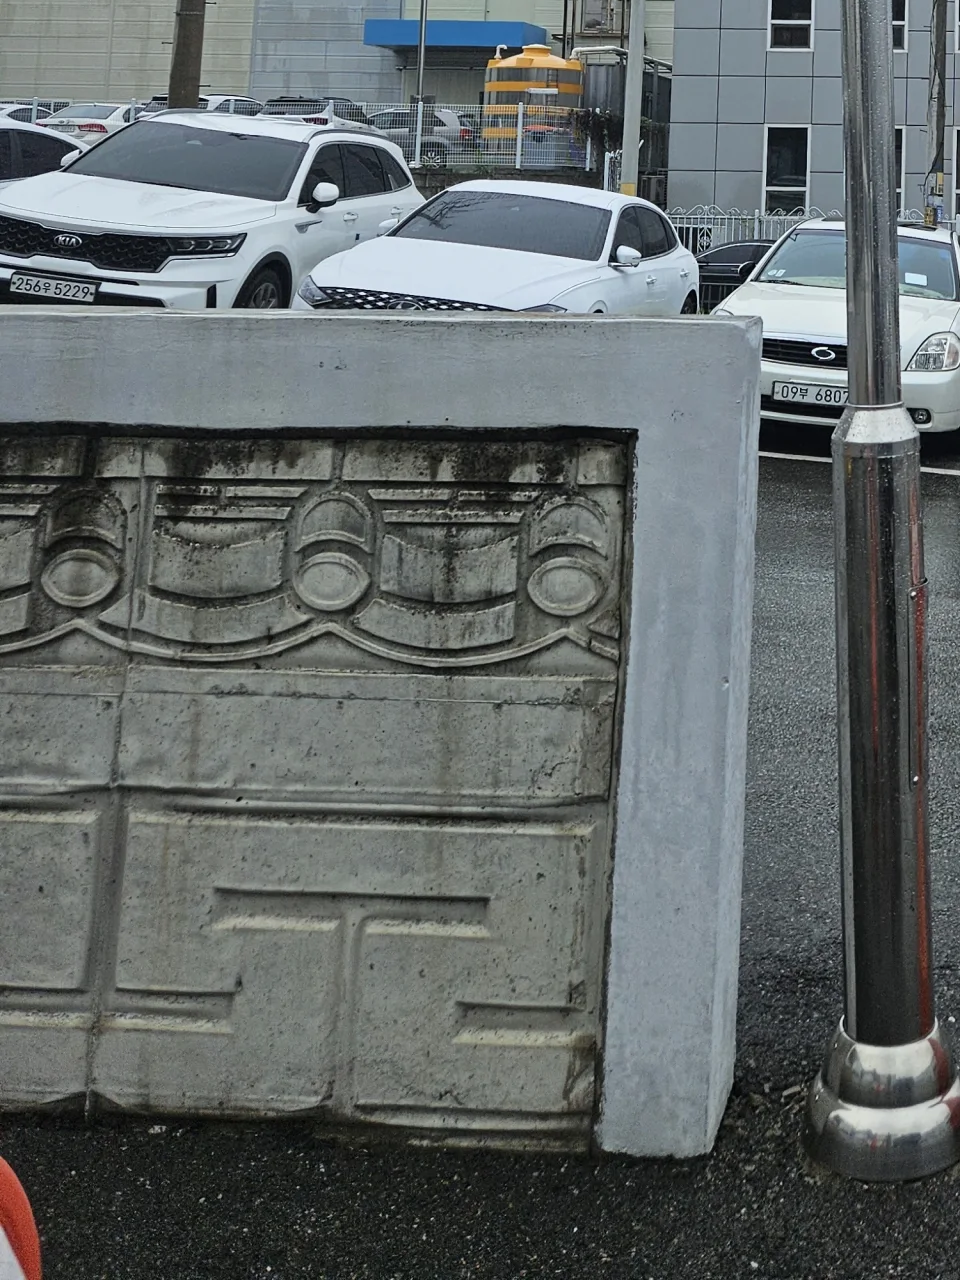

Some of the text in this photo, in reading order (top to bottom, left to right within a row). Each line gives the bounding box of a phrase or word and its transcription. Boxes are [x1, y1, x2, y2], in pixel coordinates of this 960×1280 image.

[15, 277, 90, 299] 256우 5229
[815, 388, 849, 403] 6807
